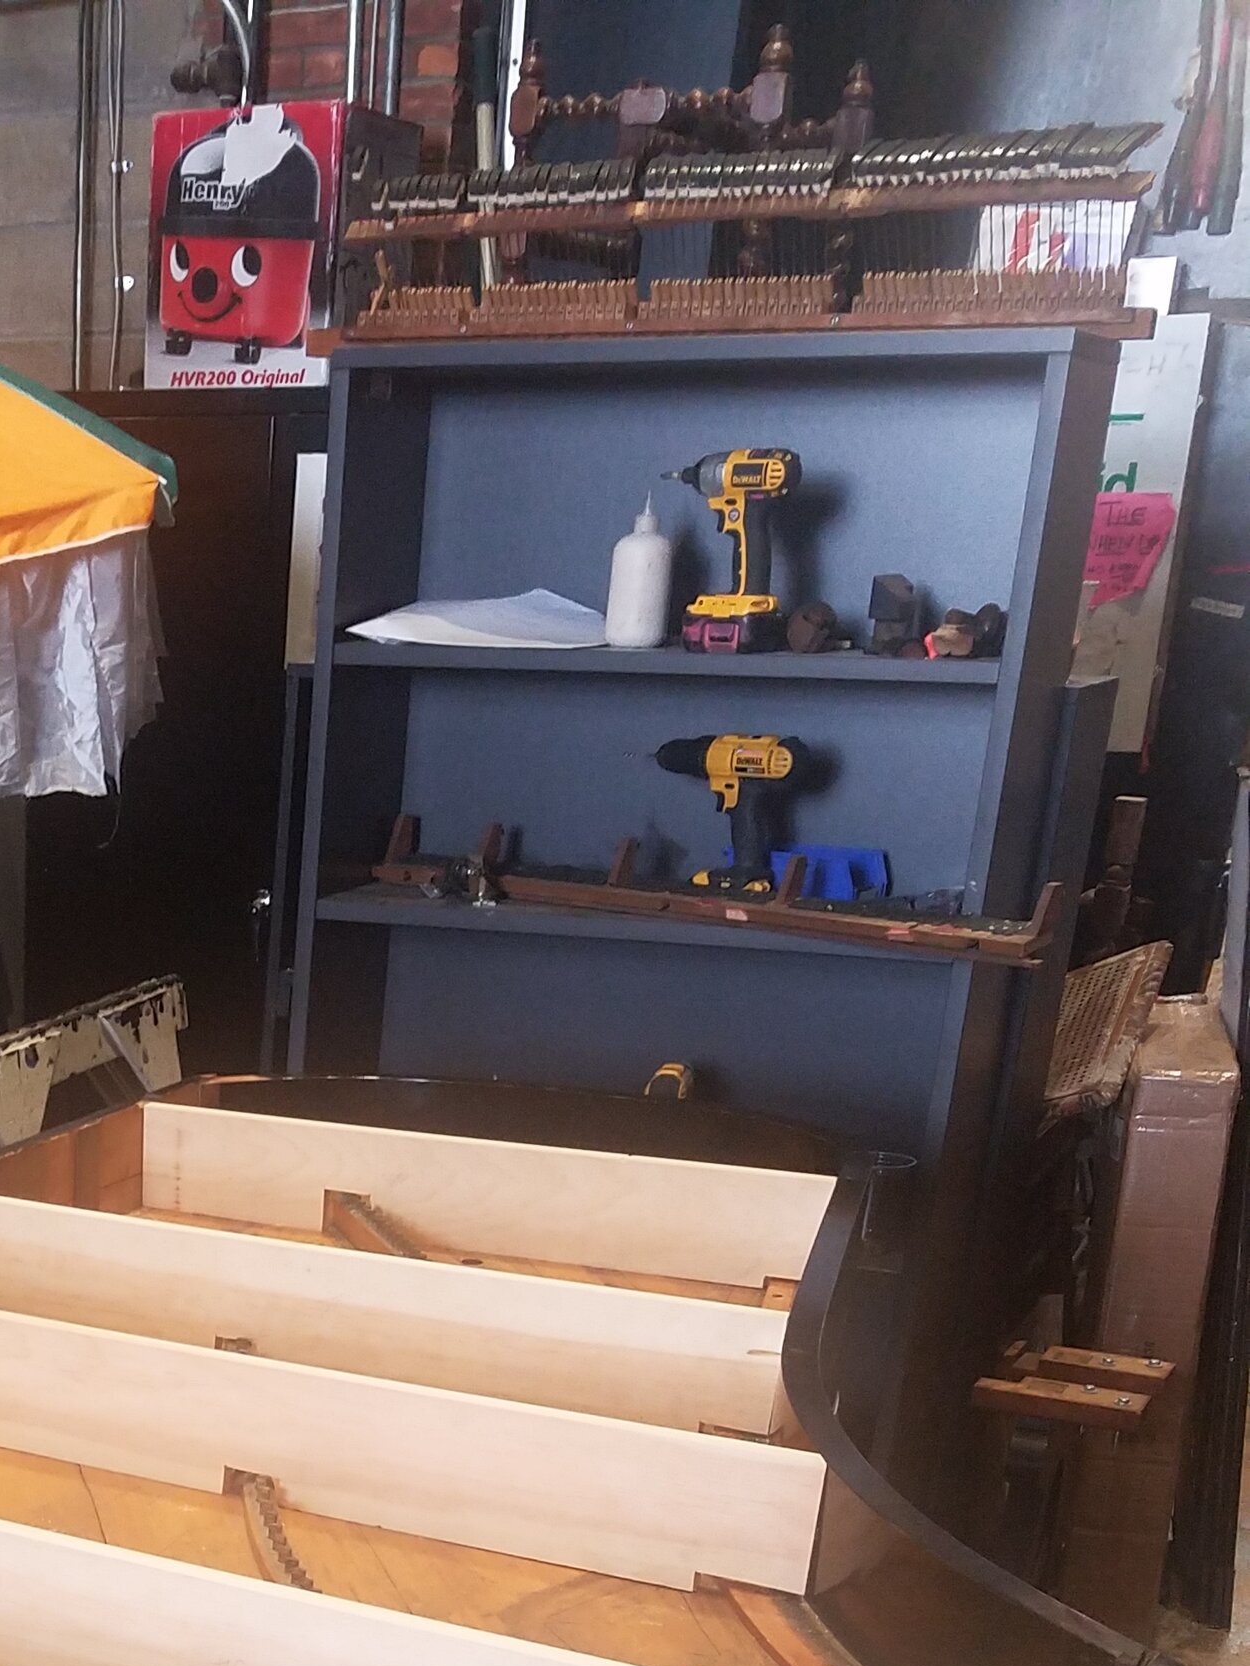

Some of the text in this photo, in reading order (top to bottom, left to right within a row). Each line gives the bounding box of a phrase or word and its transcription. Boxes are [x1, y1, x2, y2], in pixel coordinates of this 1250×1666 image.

[182, 178, 247, 208] Henry
[170, 368, 306, 388] HVR200 Original
[1099, 501, 1148, 527] THE
